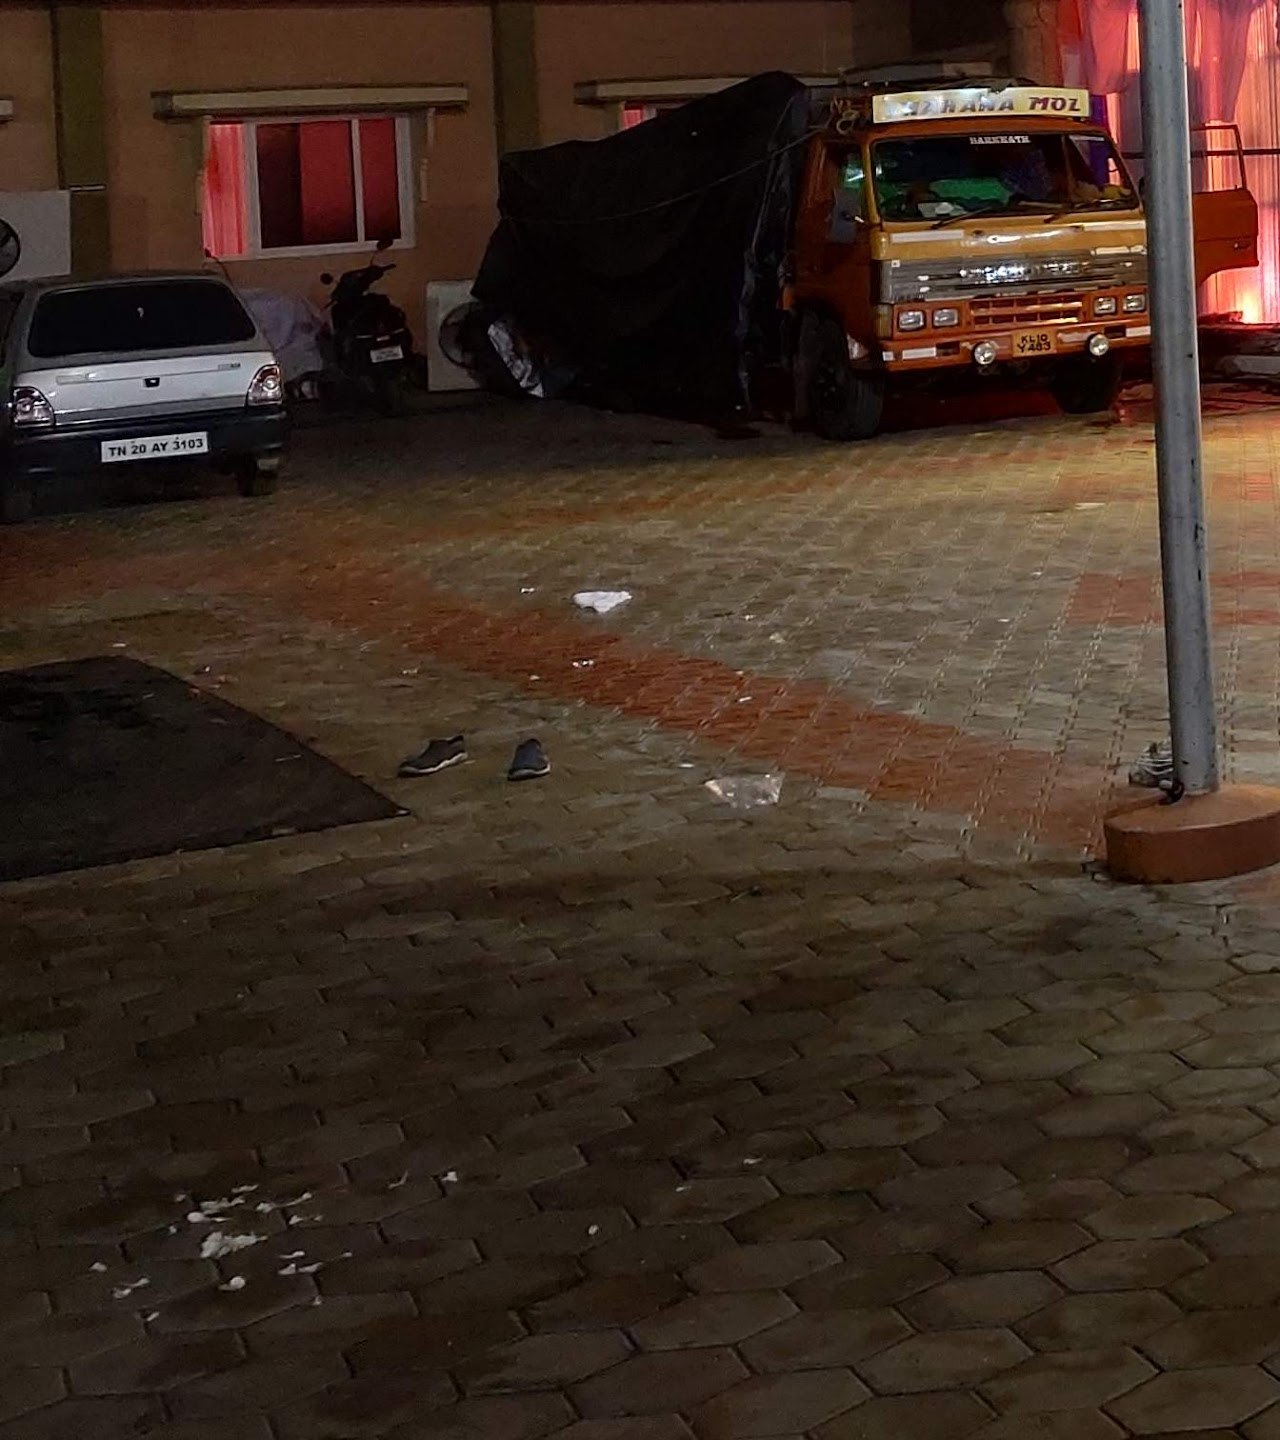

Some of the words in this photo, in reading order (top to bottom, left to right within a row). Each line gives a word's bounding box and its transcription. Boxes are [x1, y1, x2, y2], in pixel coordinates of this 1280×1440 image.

[1028, 97, 1081, 111] MOL
[108, 446, 126, 456] TN
[131, 444, 147, 454] 20
[152, 442, 168, 452] AY
[173, 439, 204, 450] 3103
